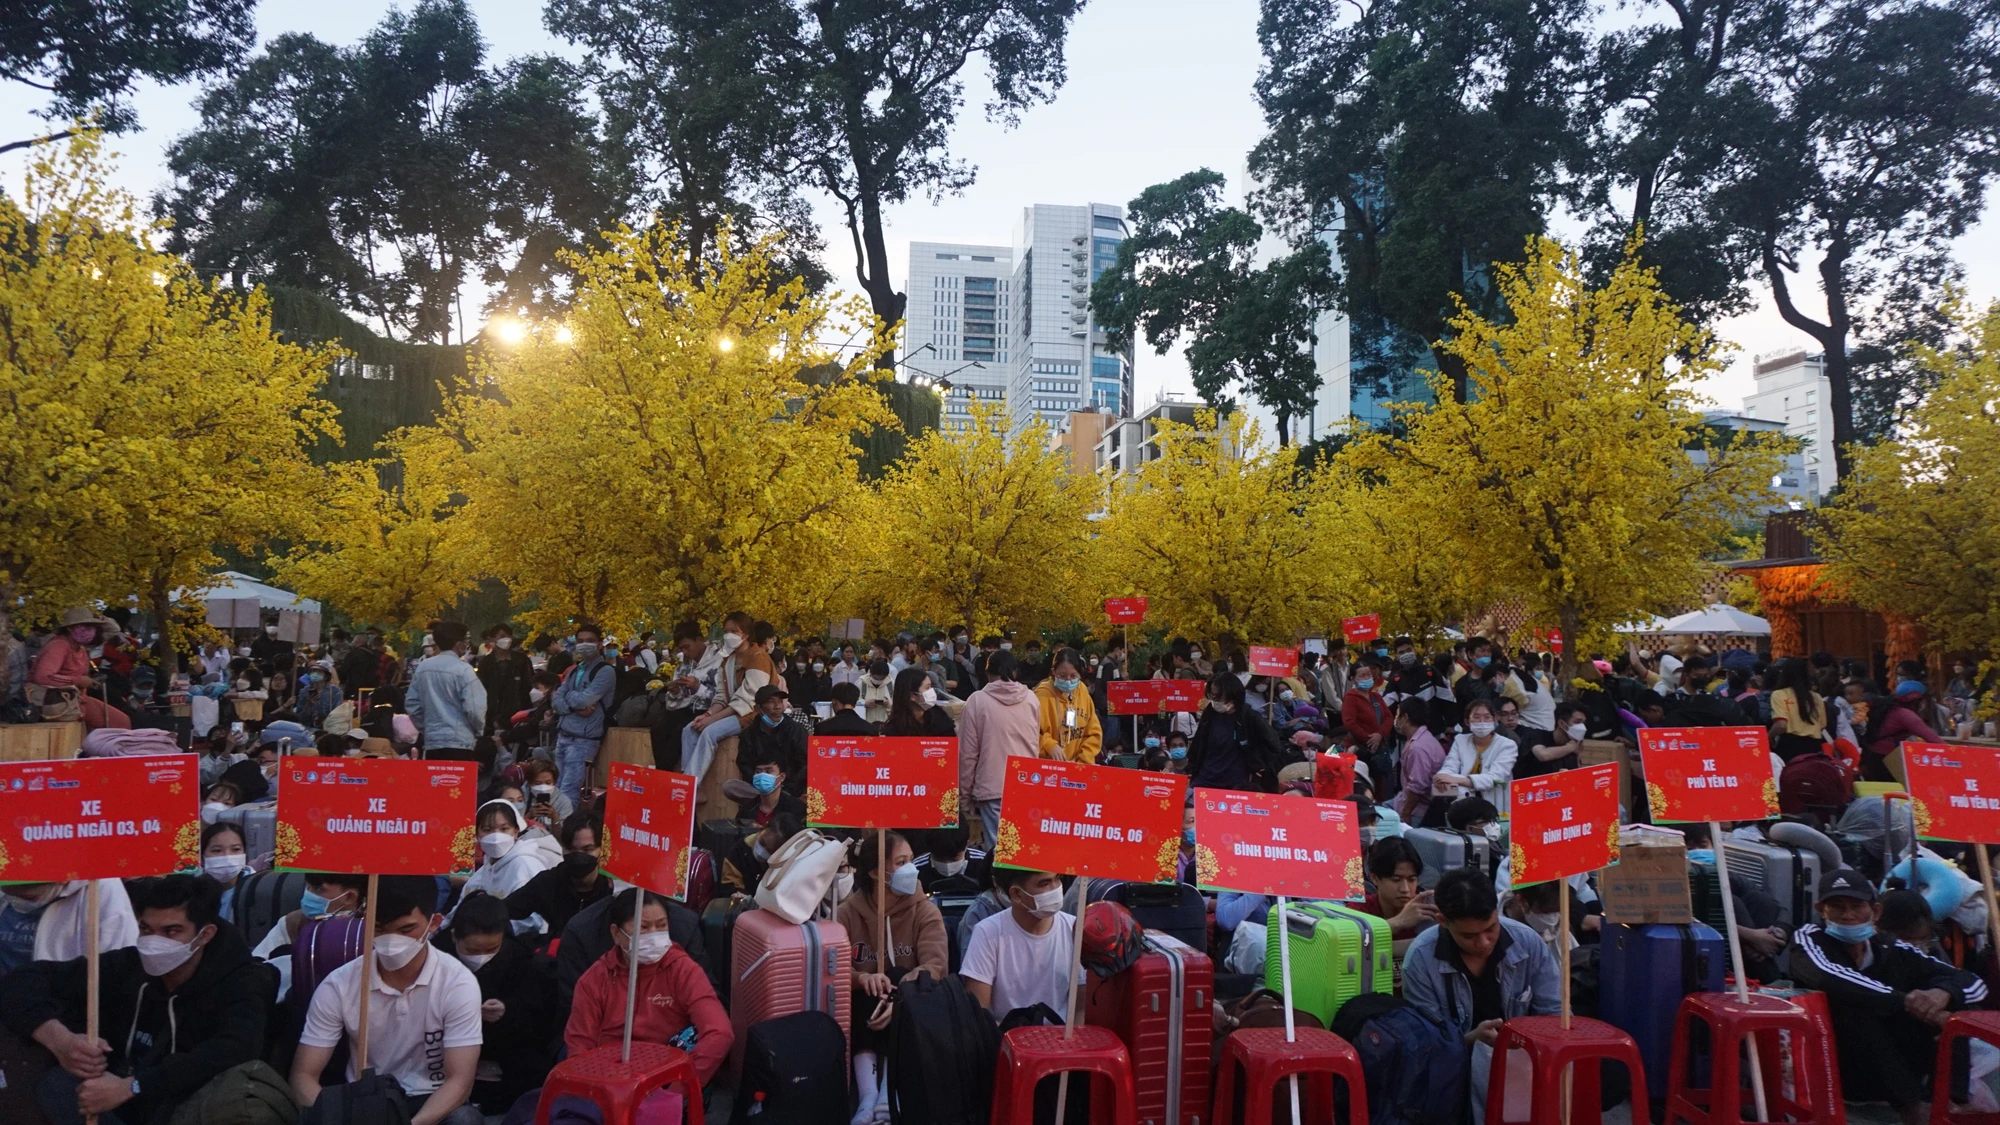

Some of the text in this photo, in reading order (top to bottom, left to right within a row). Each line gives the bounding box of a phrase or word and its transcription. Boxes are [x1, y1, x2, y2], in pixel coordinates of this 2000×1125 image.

[1703, 759, 1716, 771] XE
[876, 768, 890, 780] XE
[1687, 774, 1738, 788] PHÚ YÊN 03
[841, 782, 926, 798] BÌNH ĐỊNH 07, 08
[81, 800, 102, 816] XE
[368, 798, 387, 813] XE
[1085, 803, 1102, 818] XE
[641, 808, 651, 824] XE
[1562, 807, 1572, 821] XE
[23, 819, 161, 842] QUẢNG NGÃI 03, 04
[327, 815, 426, 834] QUẢNG NGÃI 01
[1040, 818, 1143, 843] BÌNH ĐỊNH 05, 06
[620, 823, 670, 852] BÌNH ĐỊNH 09, 10
[1271, 828, 1287, 841] XE
[1543, 823, 1592, 844] BÌNH ĐỊNH 02
[1234, 842, 1327, 863] BÌNH ĐỊNH 03, 04
